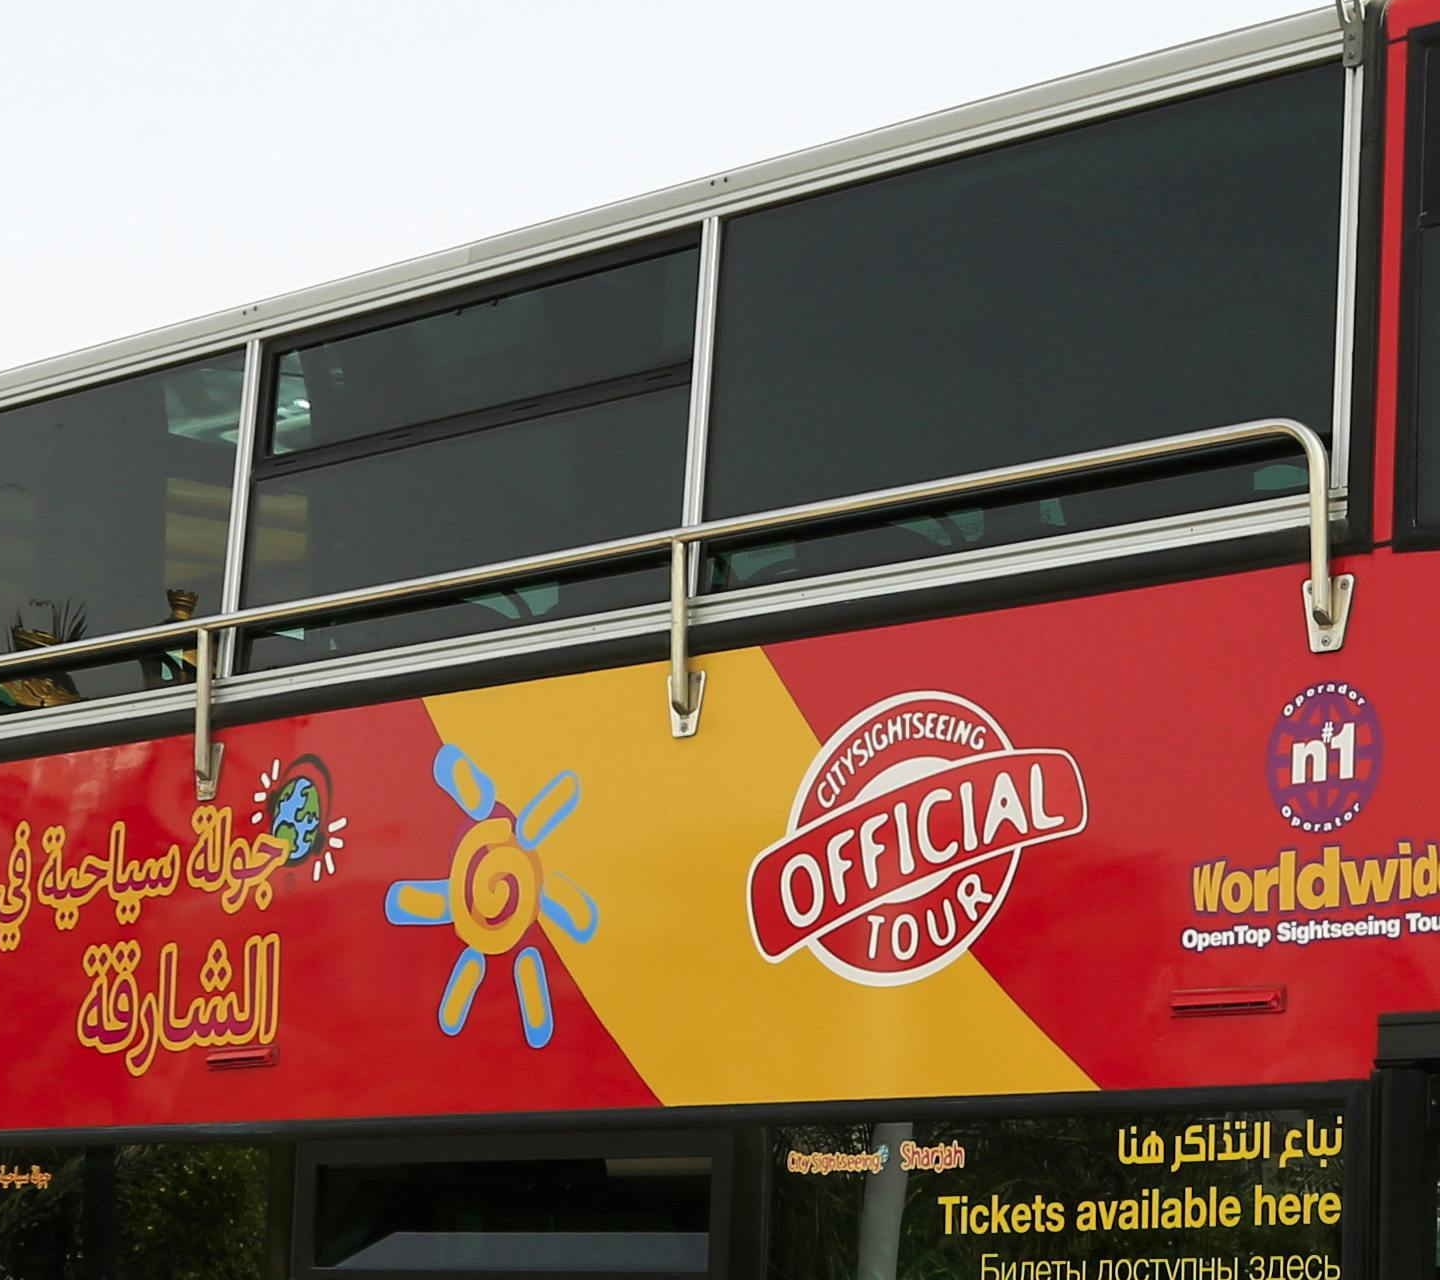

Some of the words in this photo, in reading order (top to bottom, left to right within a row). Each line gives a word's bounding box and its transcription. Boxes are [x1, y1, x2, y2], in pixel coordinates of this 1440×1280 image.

[1283, 684, 1366, 716] Operador
[817, 712, 988, 808] CITYSIGHTSEEING
[1282, 803, 1360, 832] Operator
[186, 805, 291, 914] جولة
[780, 763, 1066, 928] OFFICIAL
[37, 821, 180, 930] سياحية
[867, 873, 992, 960] TOUR
[1181, 925, 1271, 952] OpenTop
[1276, 915, 1400, 945] Sightseeing
[77, 932, 281, 1077] الشارقة
[899, 1139, 965, 1174] Sharjah
[1117, 1126, 1165, 1166] هنا
[1171, 1120, 1271, 1173] التذاكر
[938, 1194, 1065, 1234] Tickets
[1077, 1186, 1241, 1232] available
[1254, 1185, 1342, 1226] here
